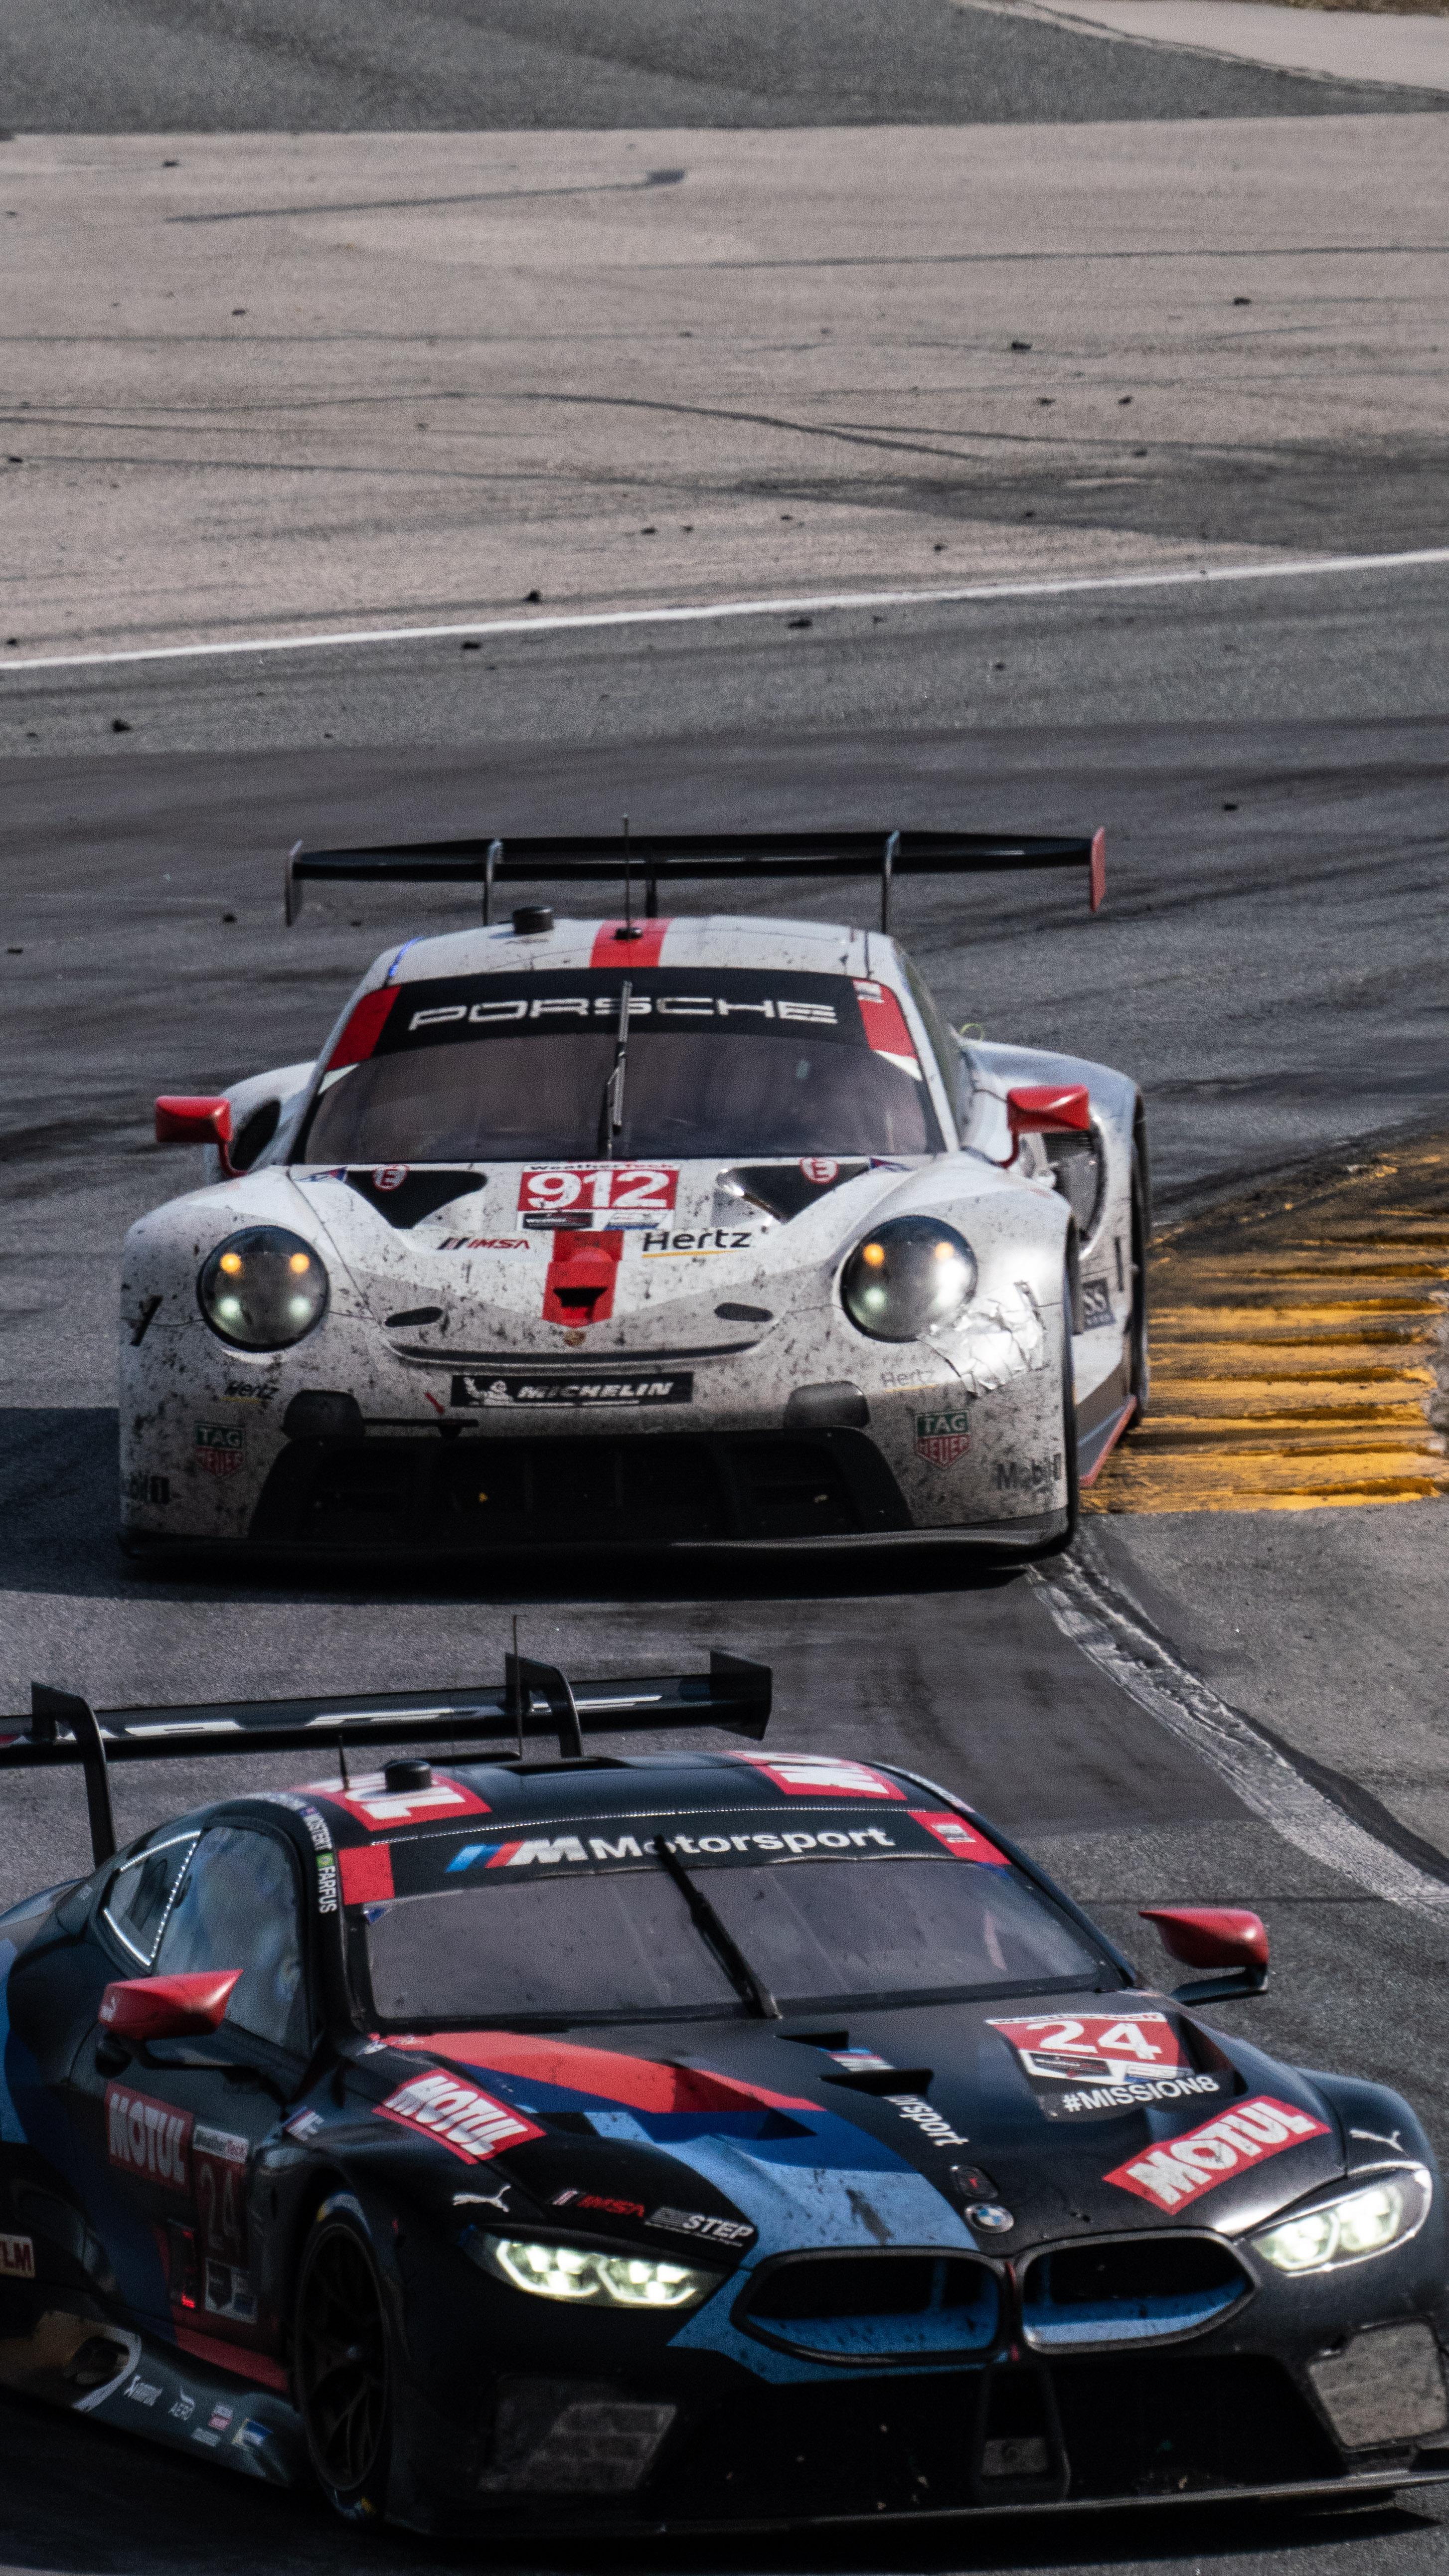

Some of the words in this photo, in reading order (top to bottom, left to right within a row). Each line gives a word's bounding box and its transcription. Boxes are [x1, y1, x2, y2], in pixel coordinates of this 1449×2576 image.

[409, 996, 838, 1031] PORSCHE
[527, 1170, 670, 1209] 912
[467, 1238, 530, 1250] IMSA
[642, 1229, 752, 1252] Hertz
[225, 1380, 279, 1399] Hertz
[516, 1382, 674, 1399] MICHELIN
[880, 1369, 935, 1387] Hertz
[199, 1427, 240, 1446] TAG
[923, 1414, 966, 1434] TAG
[917, 1437, 969, 1465] HEUER
[590, 1826, 896, 1860] Motorsport
[318, 1865, 338, 1914] FARFUS
[1025, 2020, 1162, 2060] 24
[1062, 2076, 1220, 2112] #MISSION8
[384, 2075, 529, 2156] MOTUL
[109, 2093, 185, 2186] MOTUL
[1126, 2102, 1318, 2206] MOTUL
[199, 2163, 241, 2256] 24
[577, 2194, 645, 2218] IMSA
[681, 2215, 755, 2240] STEP
[0, 2241, 31, 2271] LM
